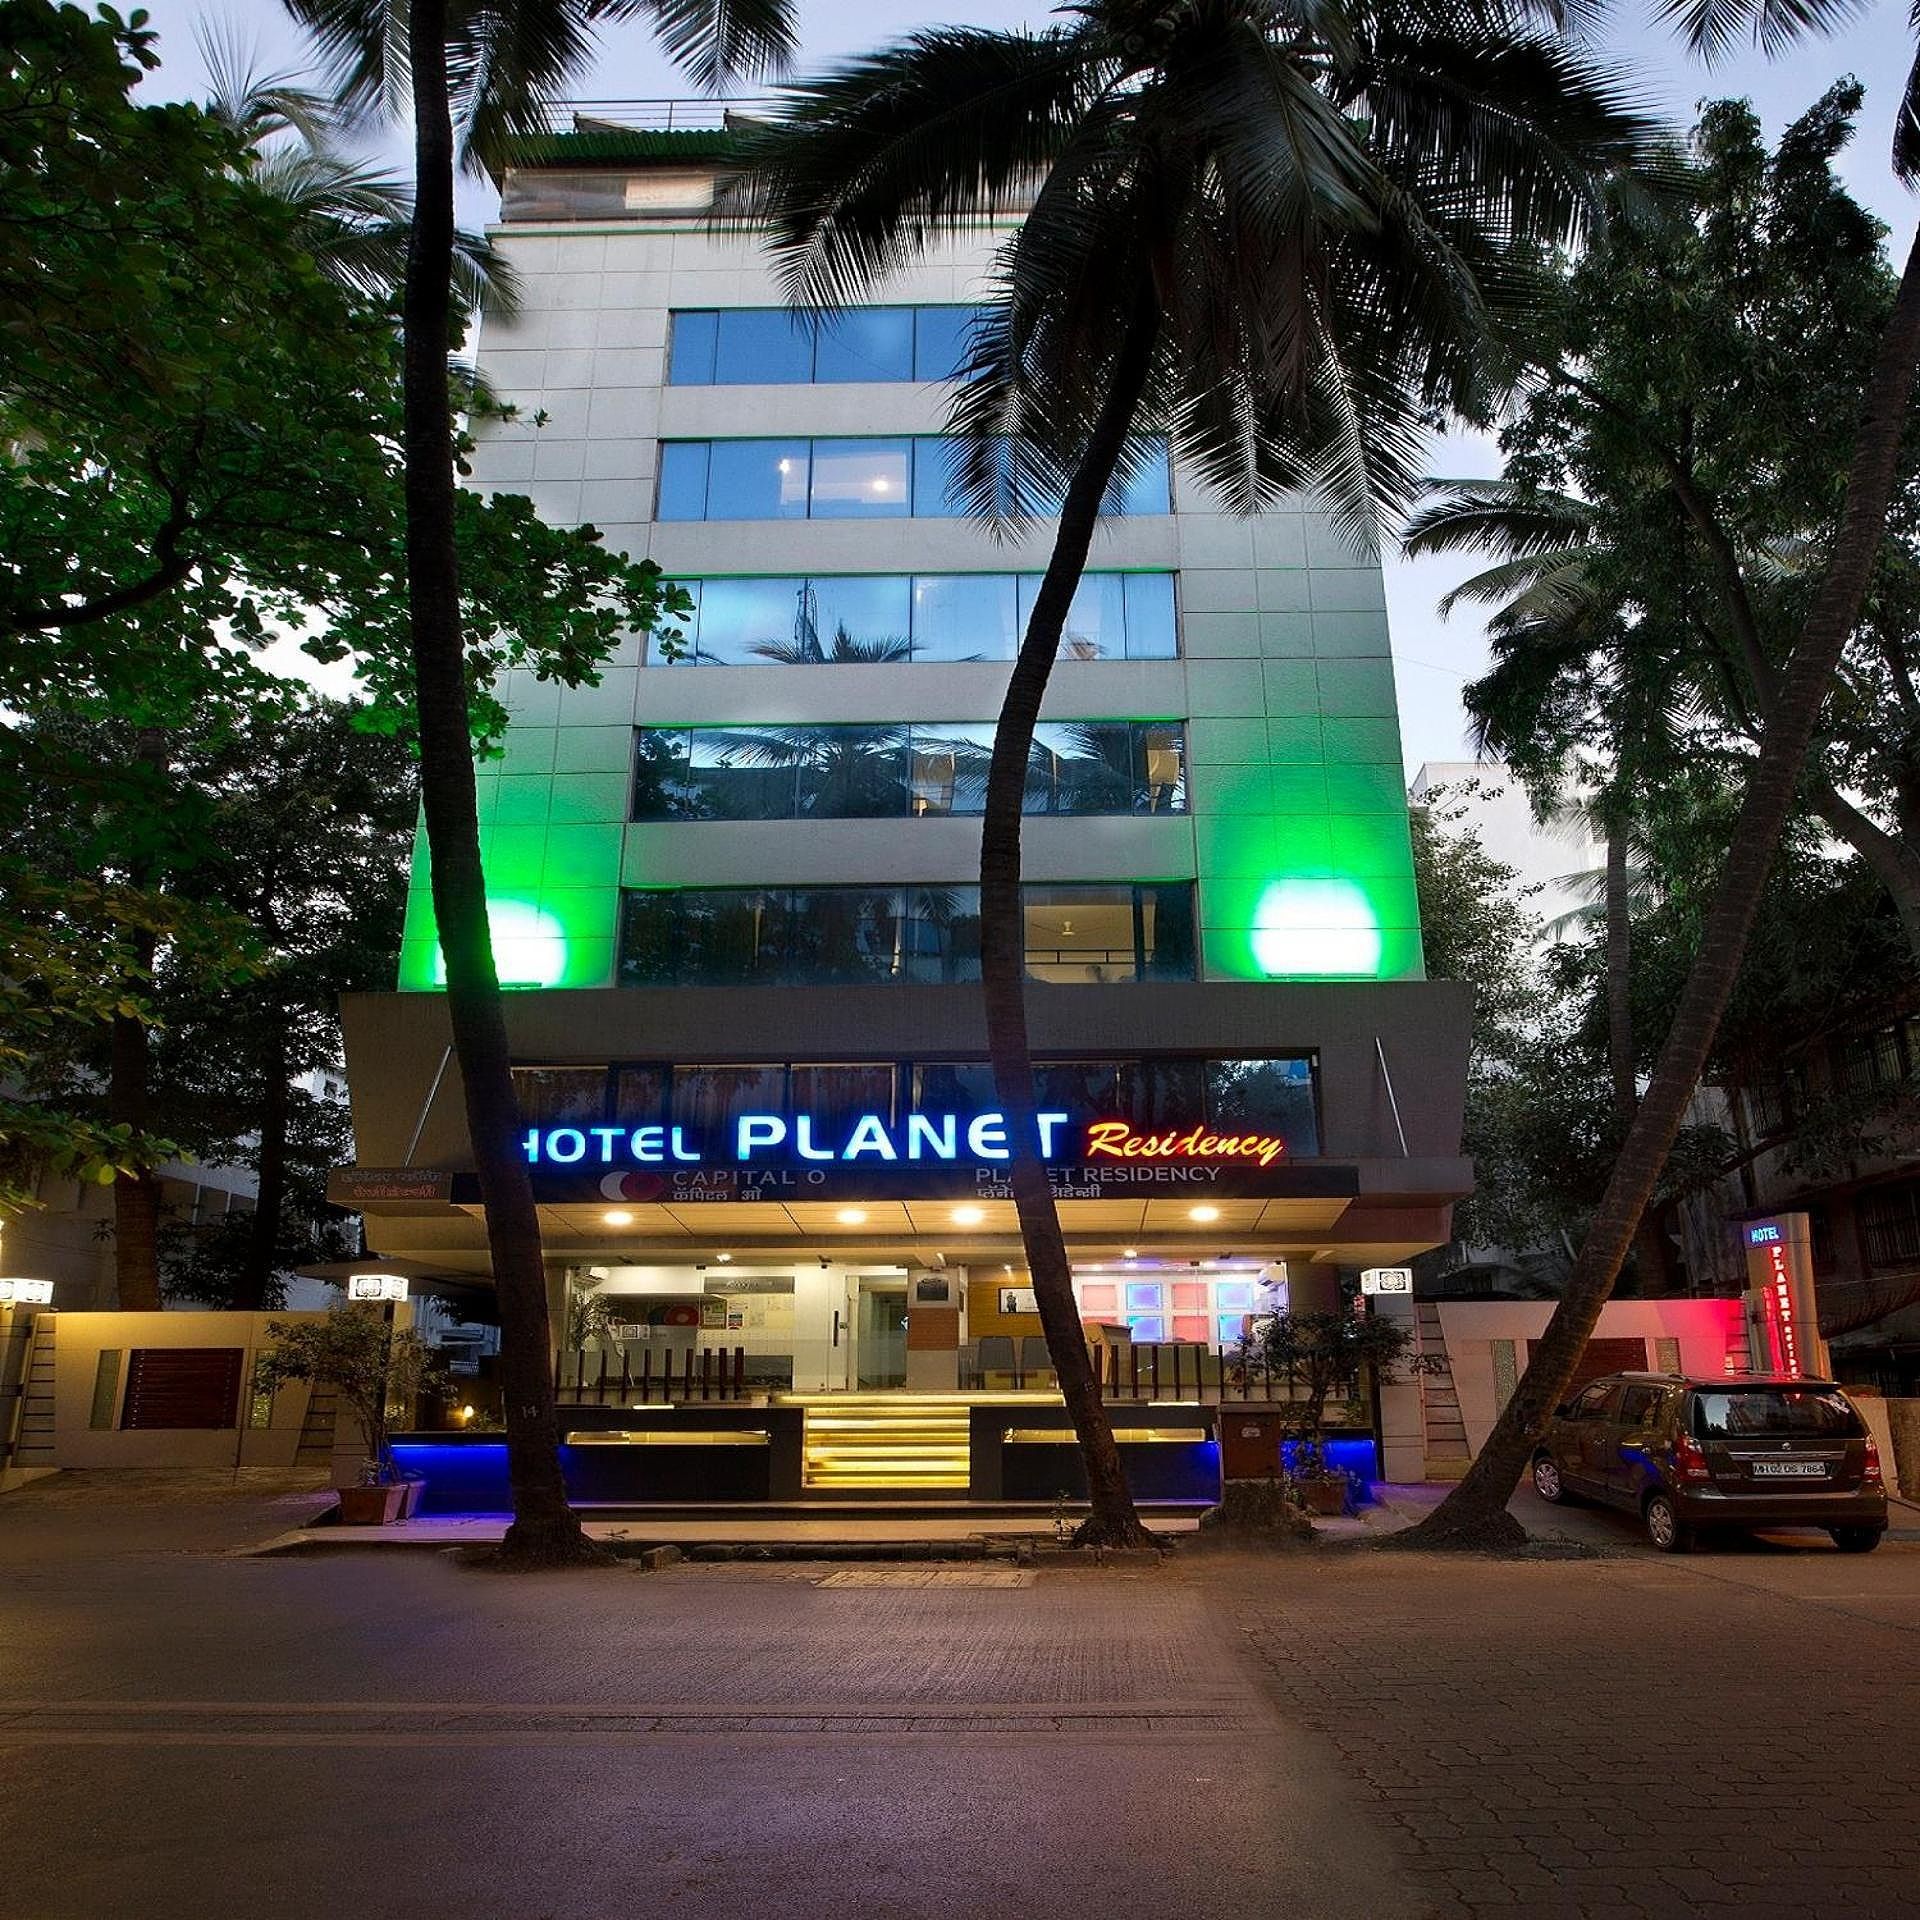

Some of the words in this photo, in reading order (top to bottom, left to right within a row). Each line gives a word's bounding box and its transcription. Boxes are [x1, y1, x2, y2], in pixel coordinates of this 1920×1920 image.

[1087, 1121, 1284, 1167] Residency
[672, 1169, 796, 1186] CAPITAL
[807, 1169, 826, 1185] O
[975, 1167, 1075, 1183] PLET
[1083, 1166, 1222, 1183] RESIDENCY
